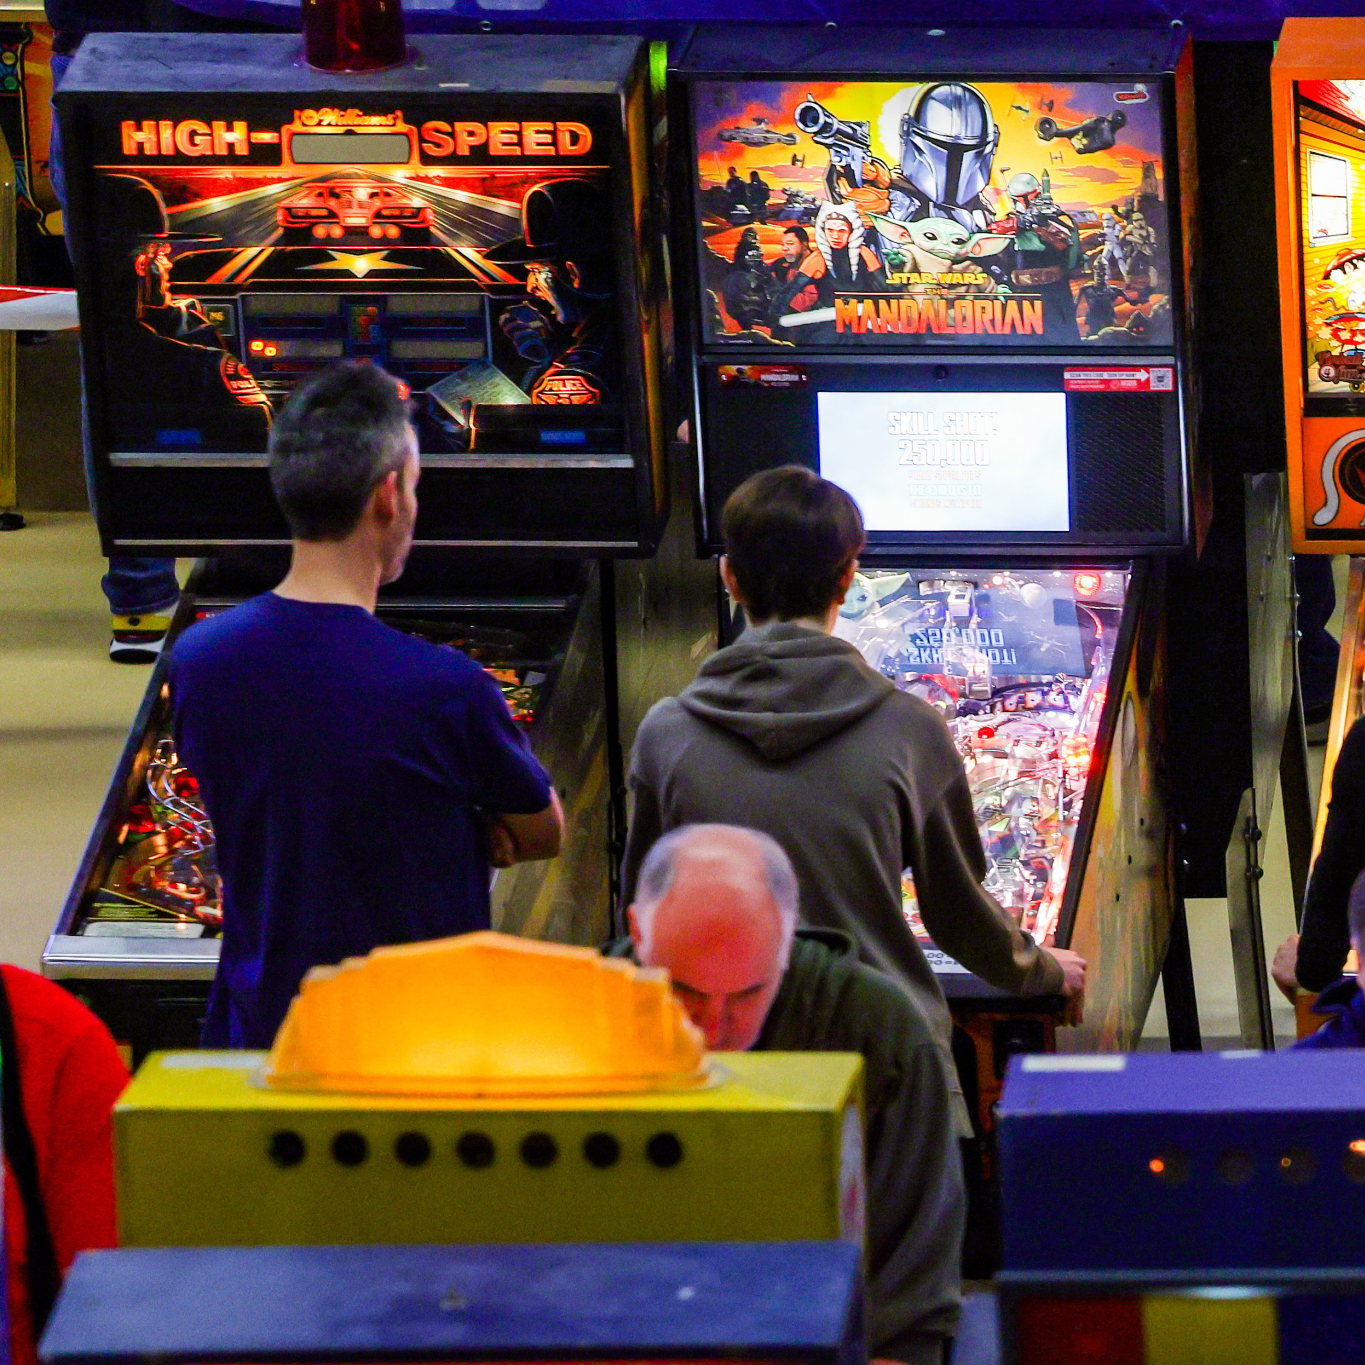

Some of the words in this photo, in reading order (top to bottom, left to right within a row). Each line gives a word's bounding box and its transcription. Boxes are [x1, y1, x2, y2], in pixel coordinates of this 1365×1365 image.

[120, 120, 280, 156] HIGH-
[421, 122, 593, 157] SPEED
[887, 272, 938, 284] STAR
[938, 272, 987, 284] WARS
[834, 299, 1045, 334] MANDALORIAN
[887, 411, 938, 435] SKILL
[898, 438, 990, 468] 250,000
